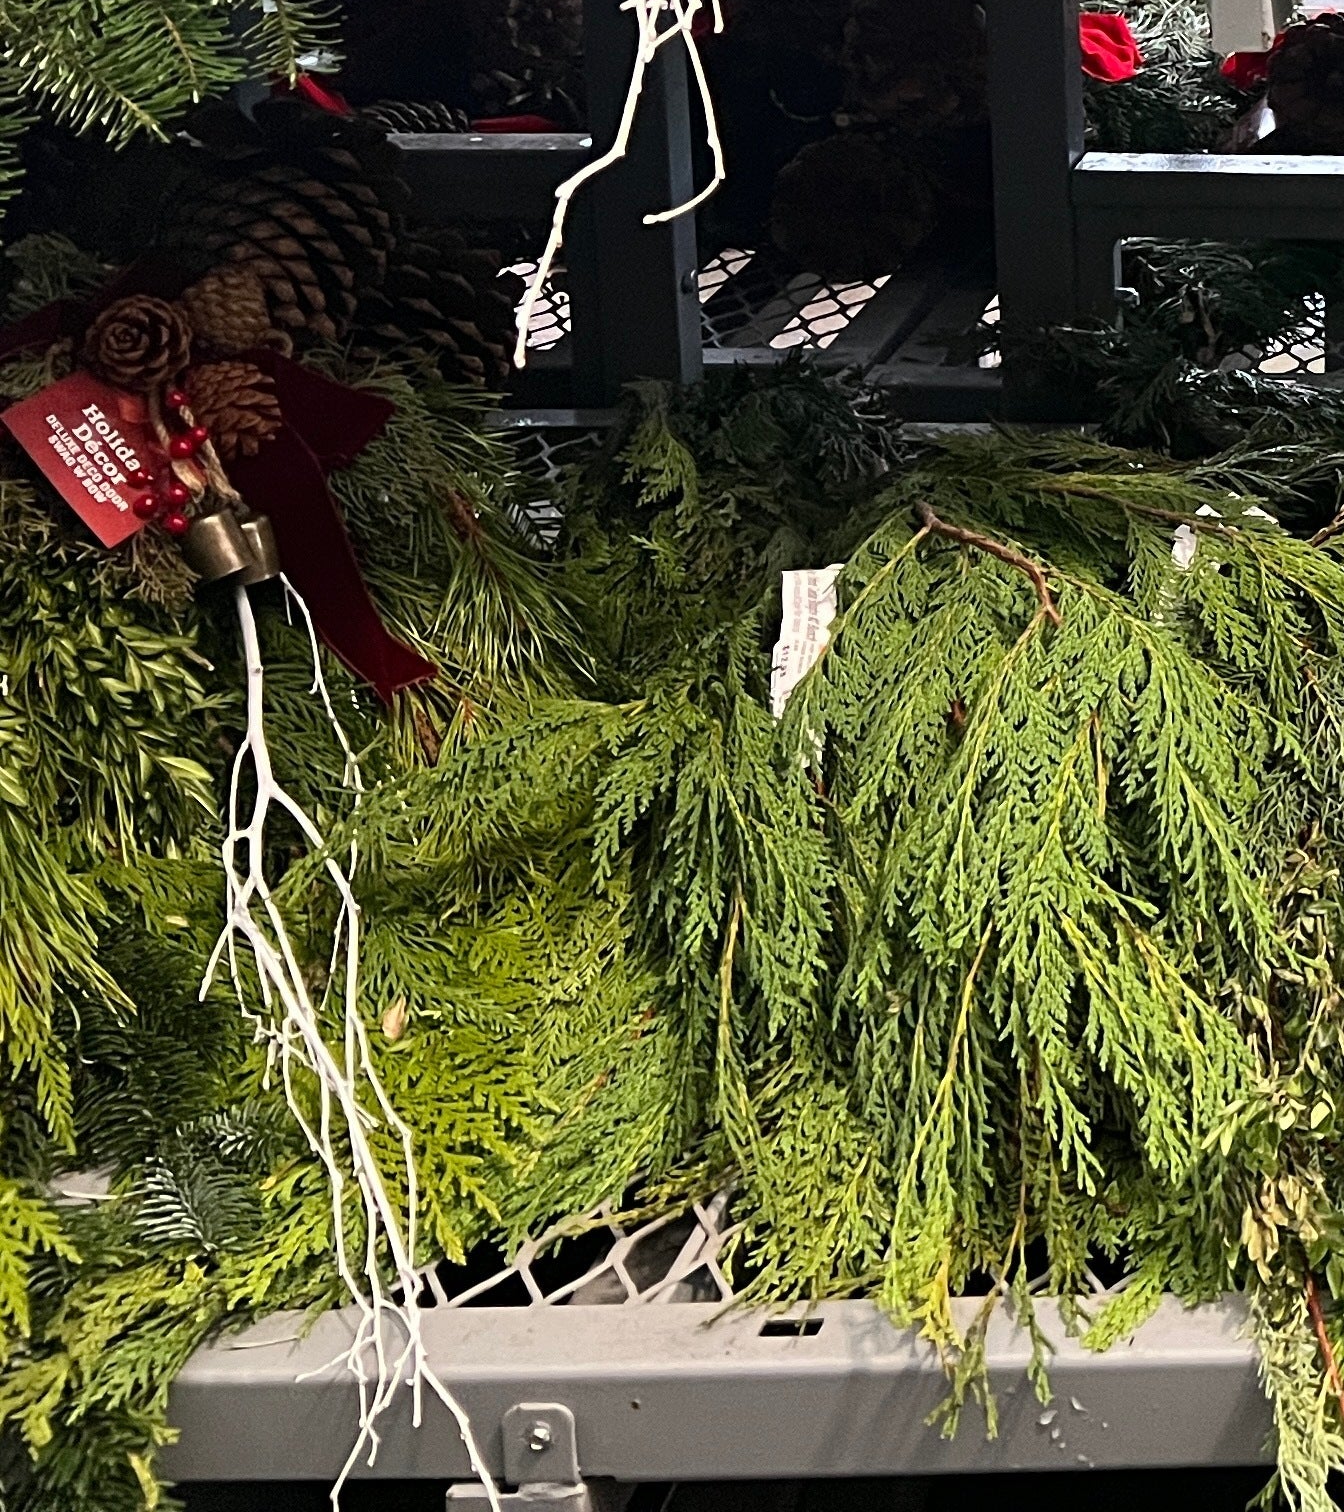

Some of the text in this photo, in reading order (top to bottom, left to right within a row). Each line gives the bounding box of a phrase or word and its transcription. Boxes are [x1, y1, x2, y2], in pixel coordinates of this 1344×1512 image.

[45, 414, 129, 512] DELUXE DECO DOOR
[48, 434, 76, 467] SWAG
[82, 478, 107, 503] BOW
[72, 422, 127, 485] Décor
[82, 403, 141, 472] Holida
